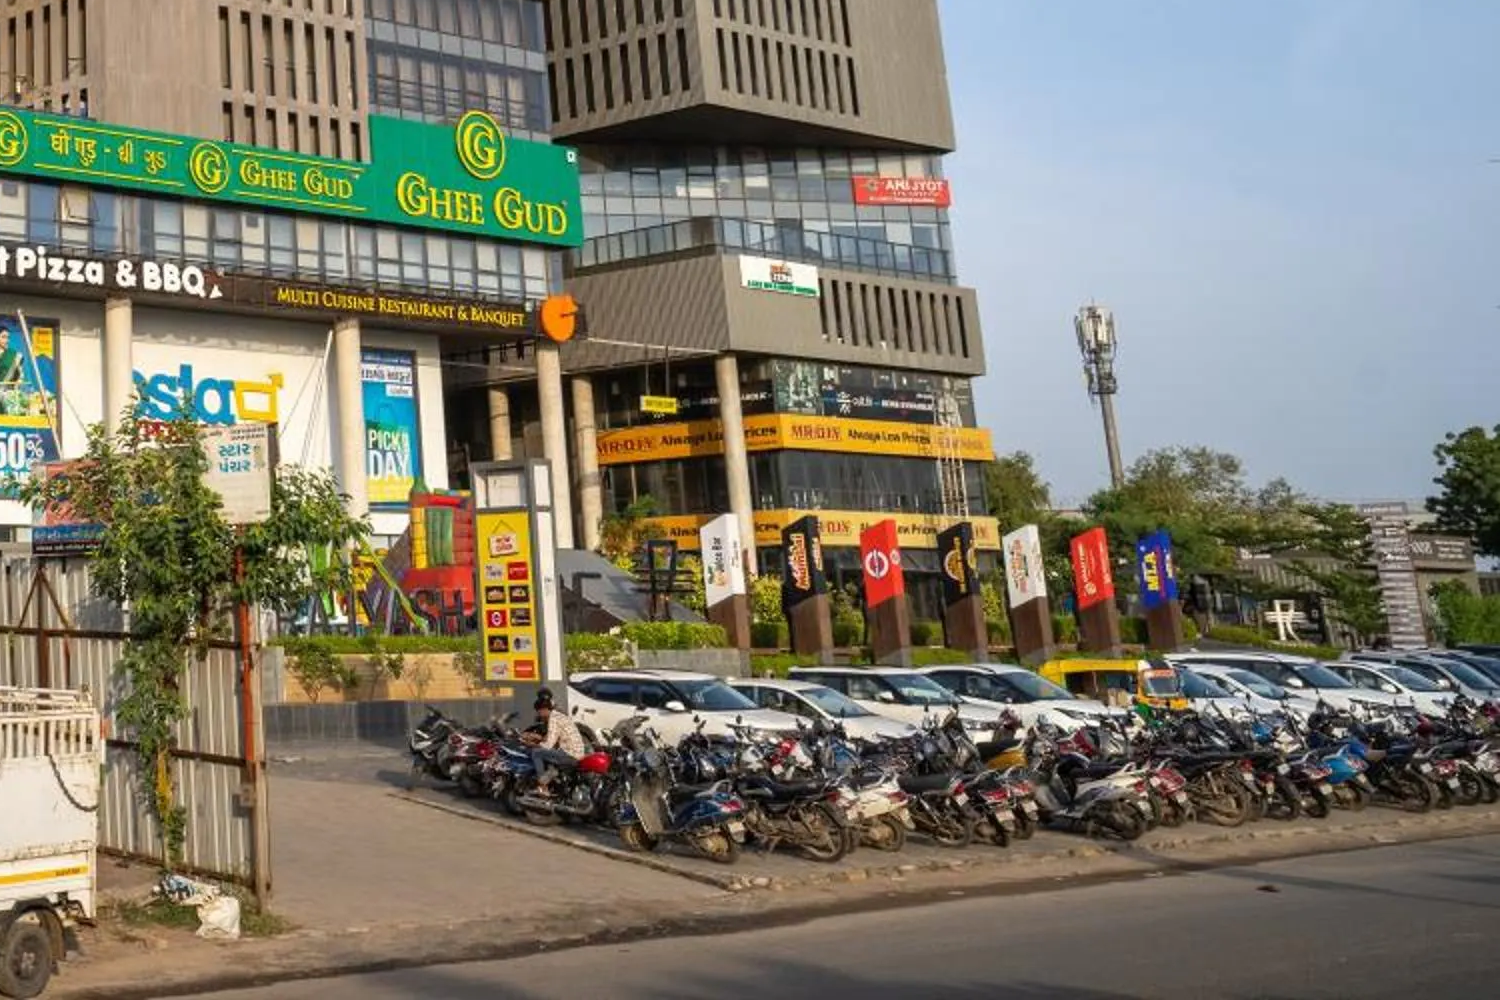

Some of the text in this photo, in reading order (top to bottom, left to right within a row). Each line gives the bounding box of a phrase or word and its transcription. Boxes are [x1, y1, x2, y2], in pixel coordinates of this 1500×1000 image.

[239, 158, 354, 199] GHEE GUD
[396, 171, 568, 236] GHEE GUD
[16, 249, 105, 285] Pizza
[115, 260, 138, 289] &
[143, 261, 206, 299] BBQ
[277, 286, 525, 328] MULTI CUISINE RESTAURANT & BANQUET
[745, 425, 777, 438] rices
[368, 449, 411, 479] DAY
